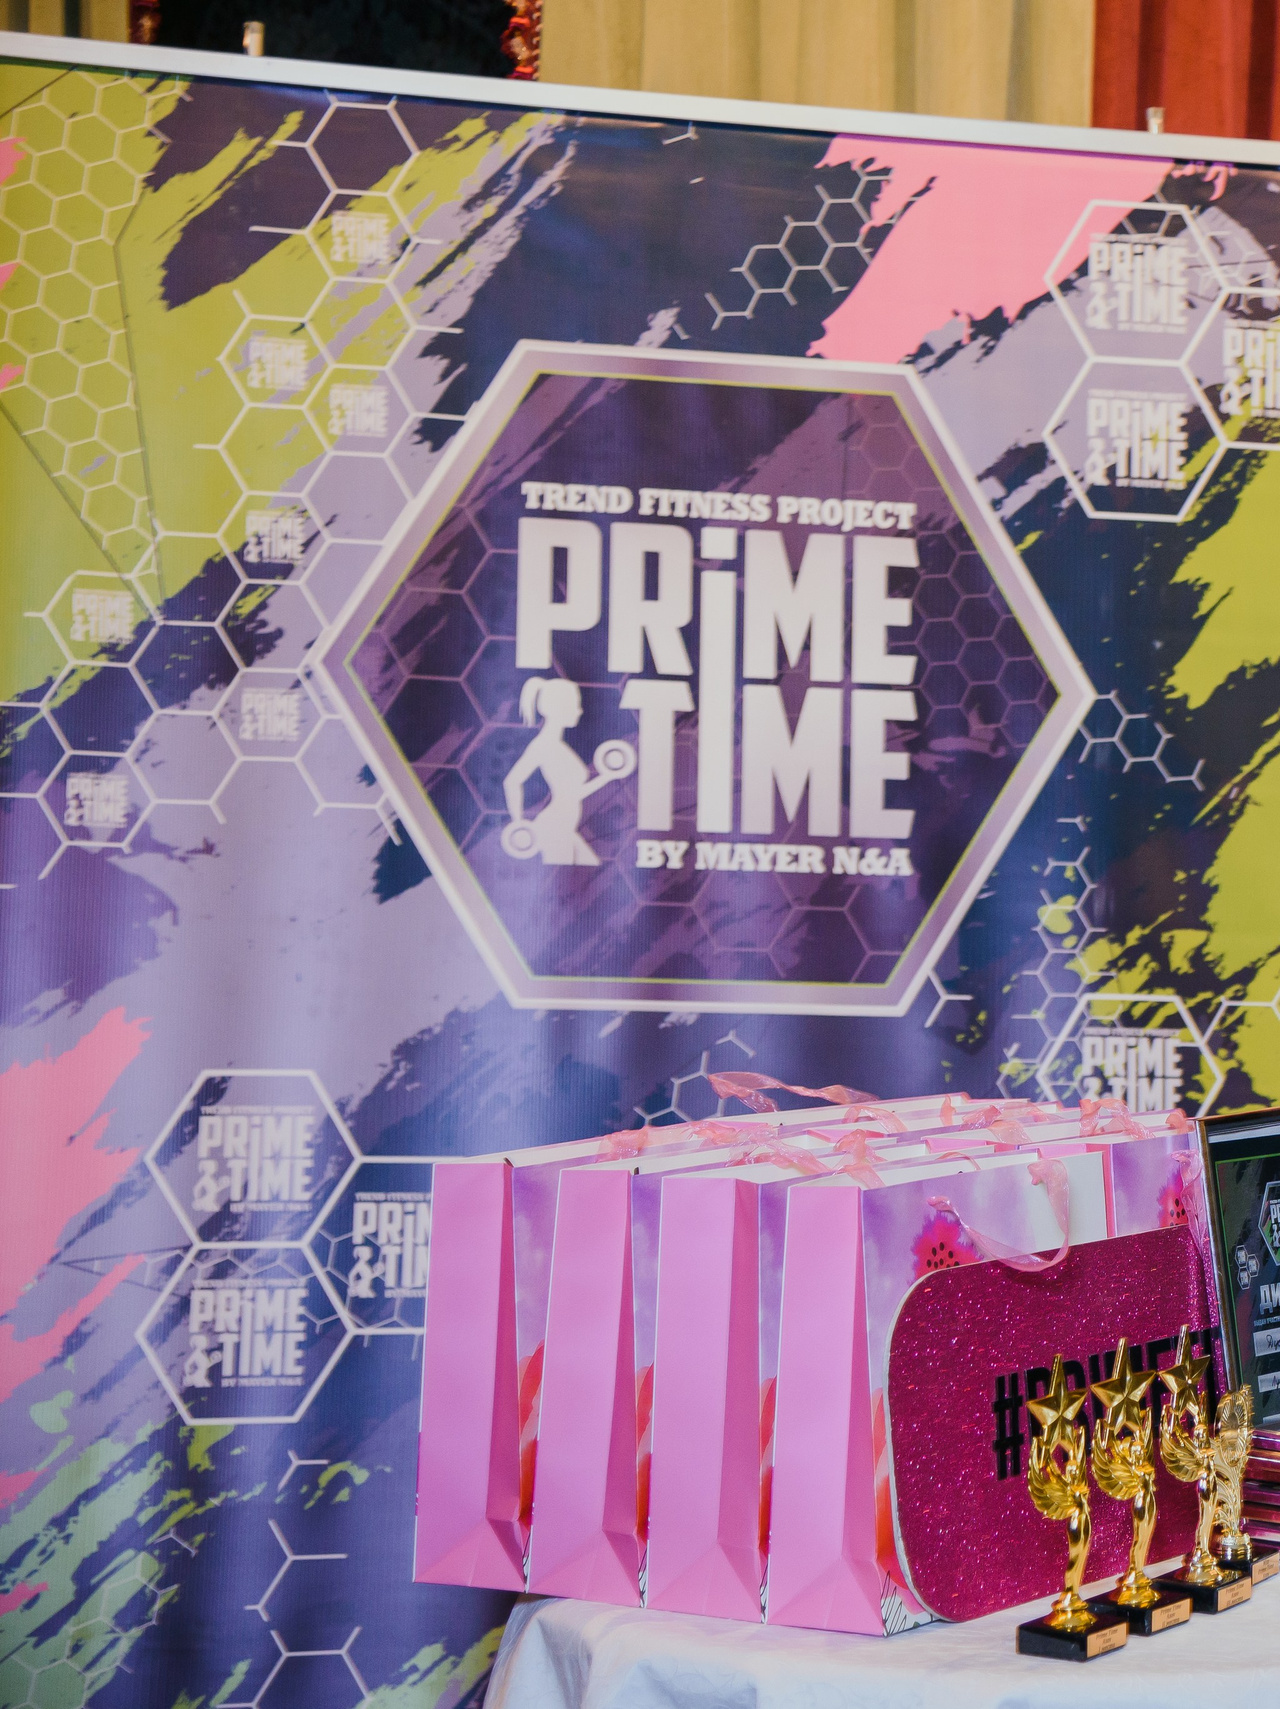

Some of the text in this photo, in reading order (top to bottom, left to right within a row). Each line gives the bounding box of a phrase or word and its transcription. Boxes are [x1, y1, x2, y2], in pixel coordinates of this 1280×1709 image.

[521, 481, 917, 532] TREND FITNESS PROJECT
[619, 678, 918, 839] TIME
[636, 839, 915, 876] BY MAYER N&A
